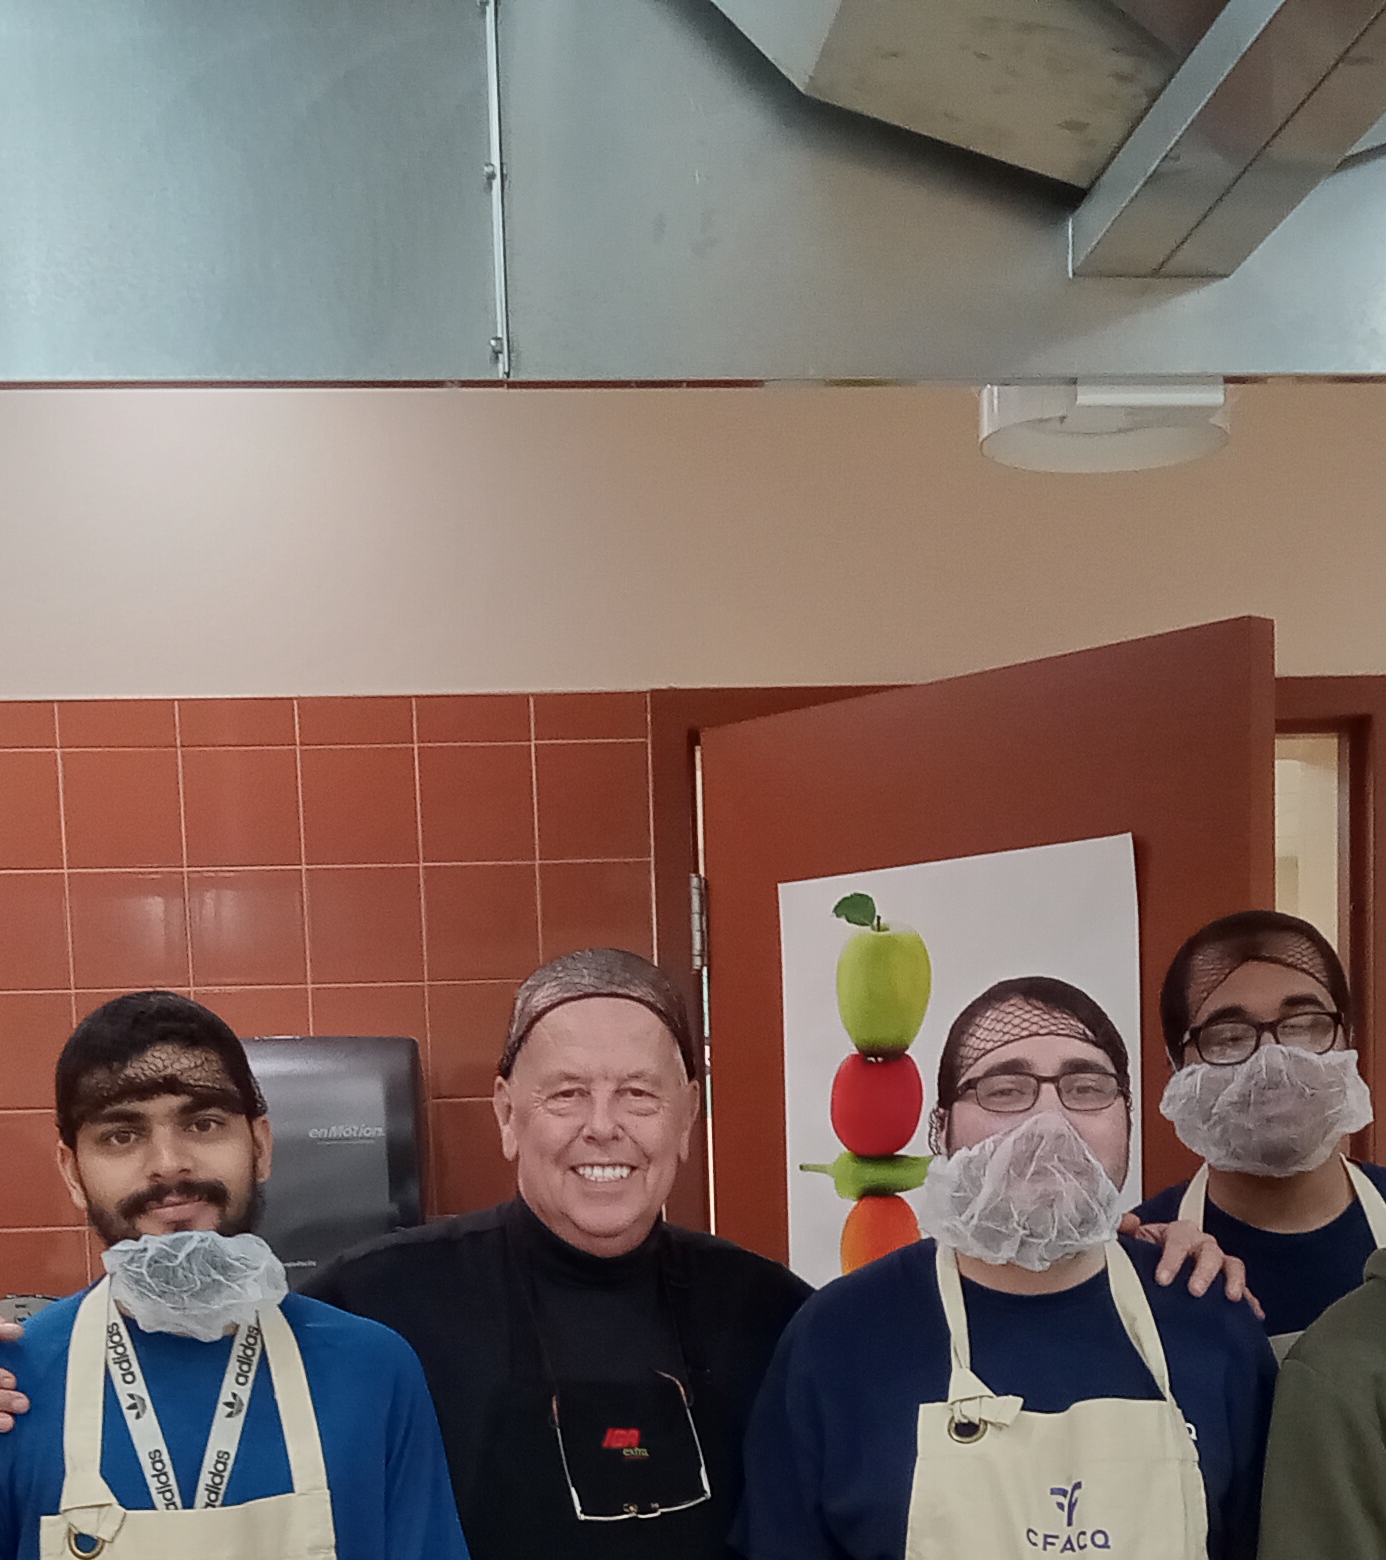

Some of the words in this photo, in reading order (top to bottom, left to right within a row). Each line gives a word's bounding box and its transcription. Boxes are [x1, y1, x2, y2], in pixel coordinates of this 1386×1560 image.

[108, 1322, 136, 1385] adidas
[236, 1325, 260, 1387] adidas
[1025, 1527, 1112, 1554] CFACQ
